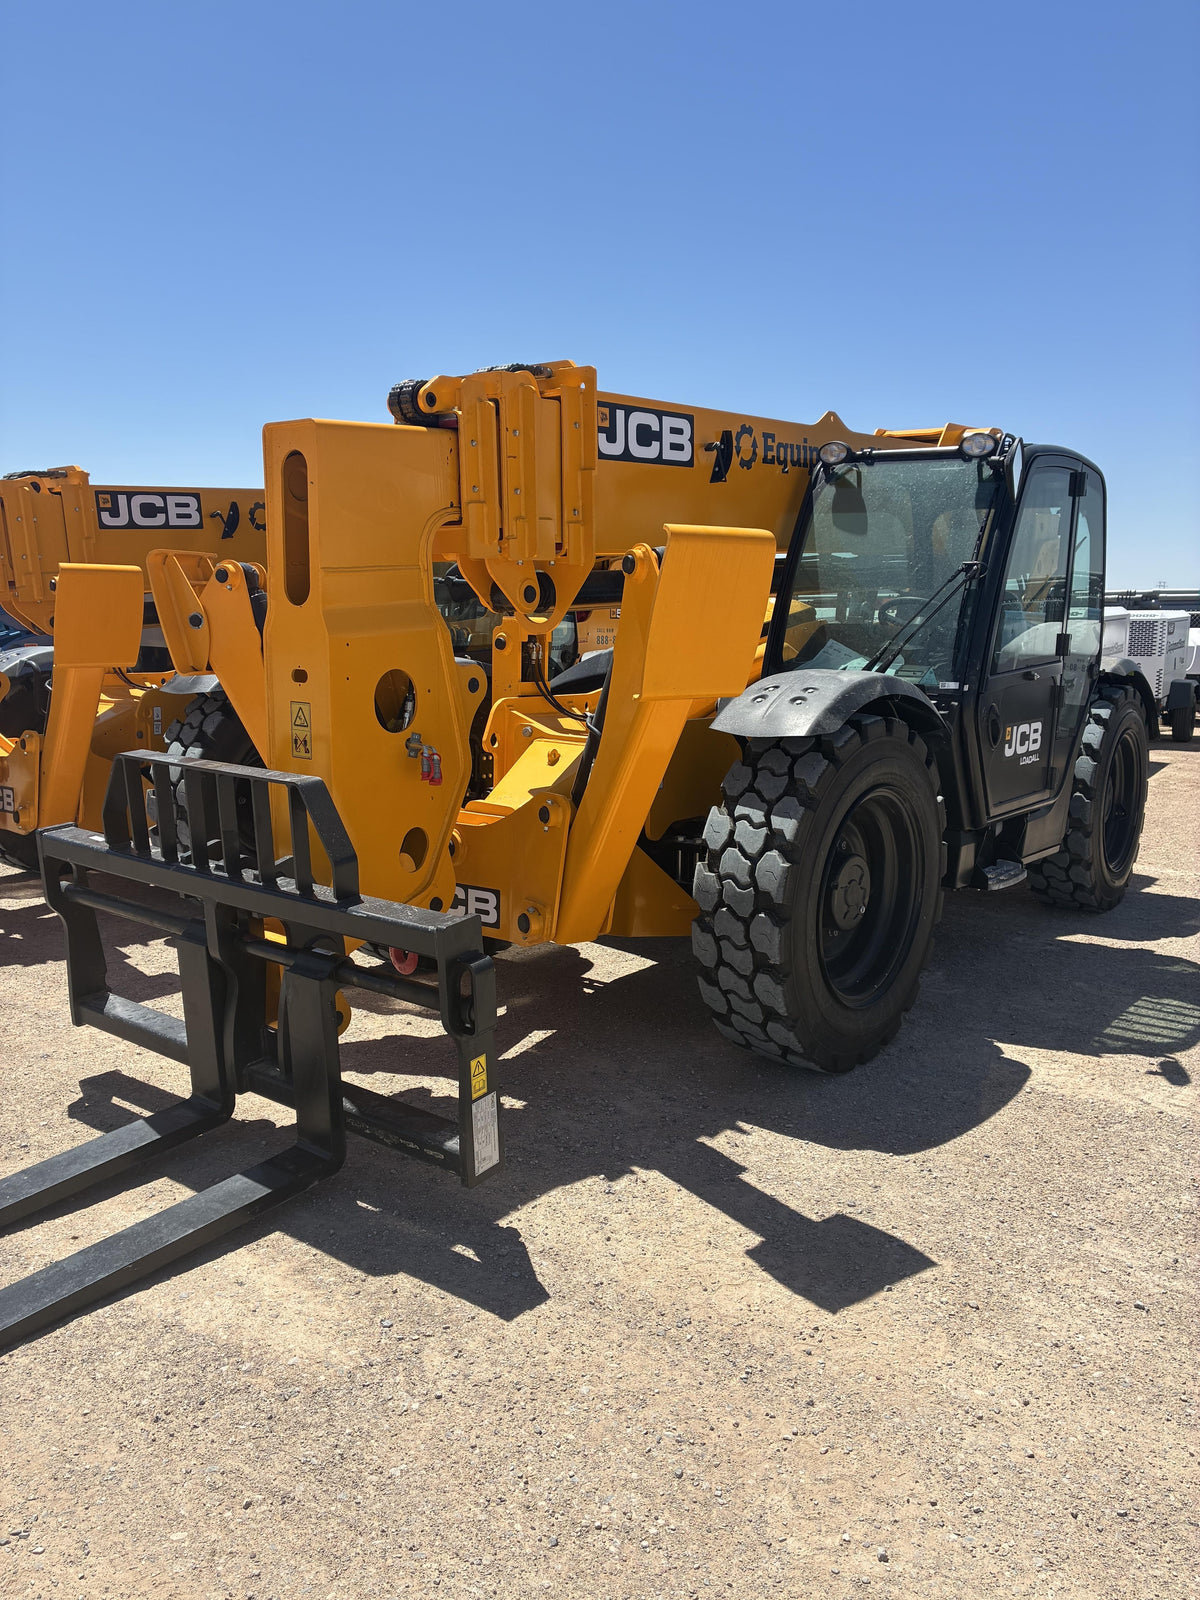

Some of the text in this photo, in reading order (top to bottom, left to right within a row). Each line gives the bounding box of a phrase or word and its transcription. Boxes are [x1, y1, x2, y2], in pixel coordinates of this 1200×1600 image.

[598, 409, 692, 462] JCB
[100, 494, 200, 526] JCB
[1004, 721, 1042, 757] JCB
[1019, 753, 1040, 765] LOADALL
